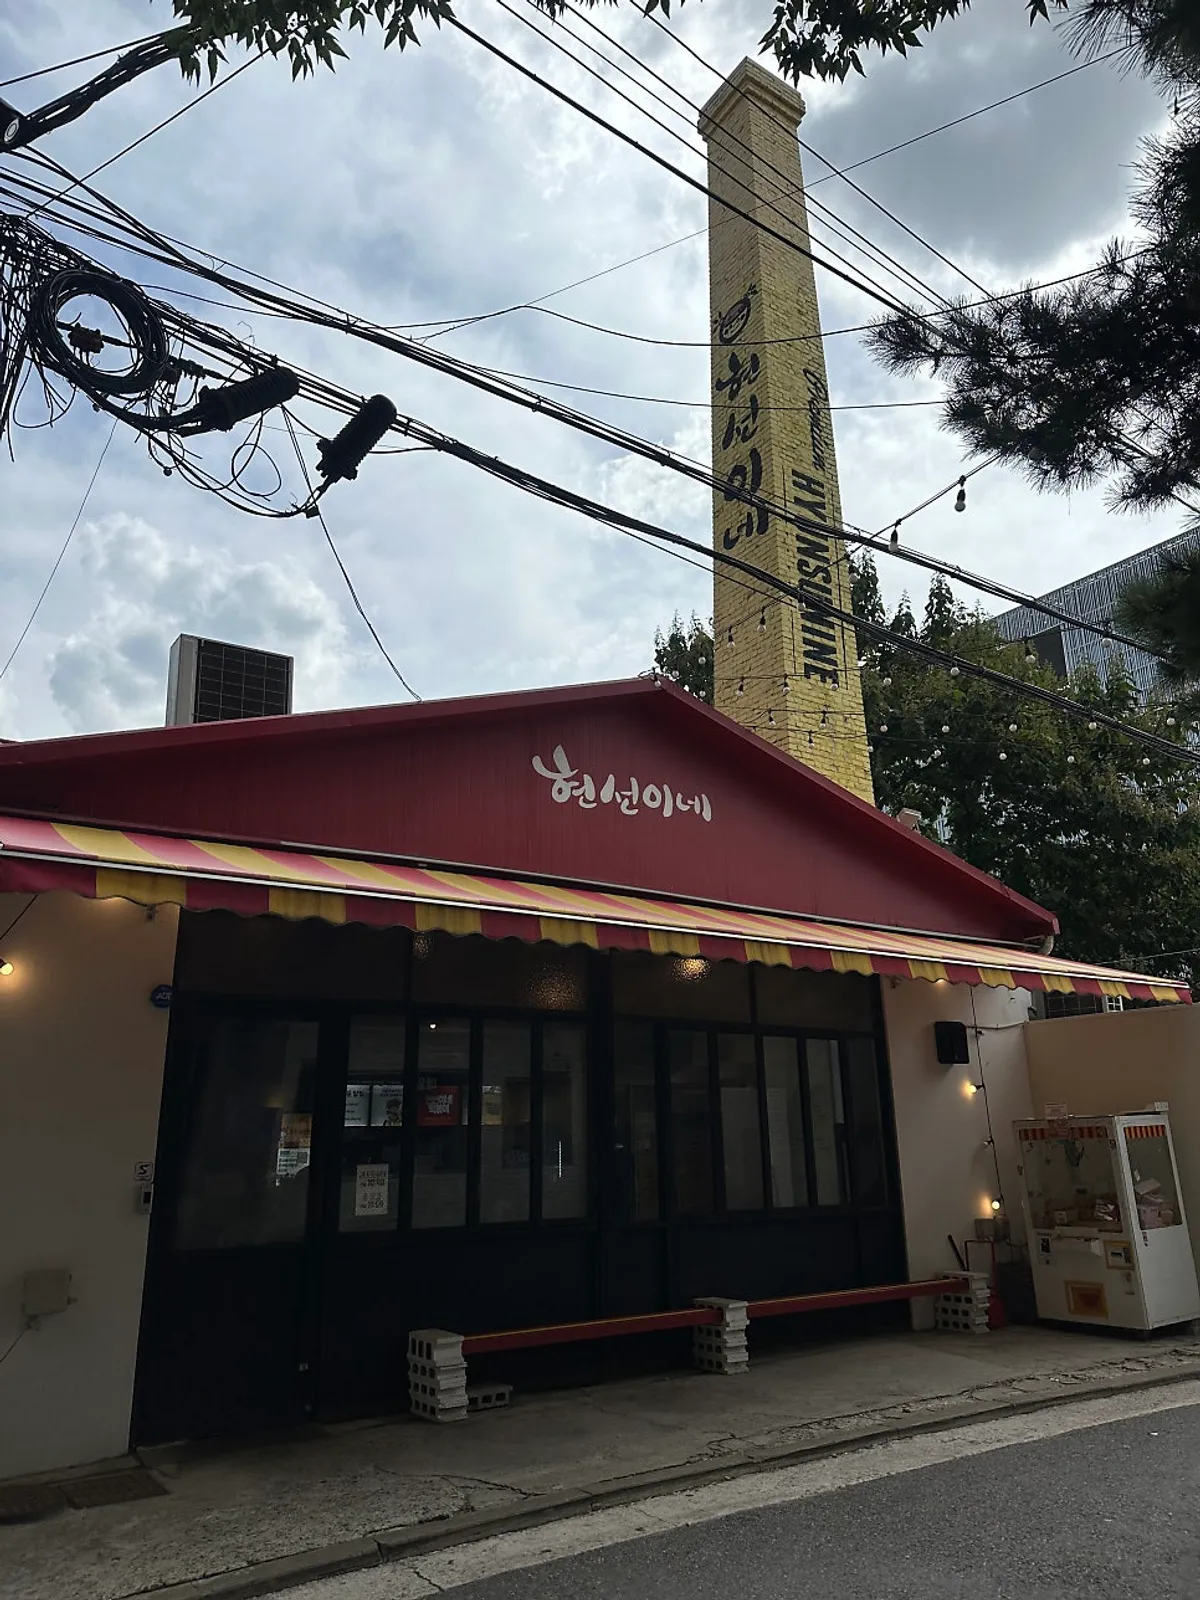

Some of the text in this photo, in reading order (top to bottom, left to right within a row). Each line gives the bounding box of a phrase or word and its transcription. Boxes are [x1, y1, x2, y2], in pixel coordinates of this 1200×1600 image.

[715, 352, 769, 550] 현선이네
[803, 368, 829, 472] Premium
[531, 744, 712, 822] 현선이네
